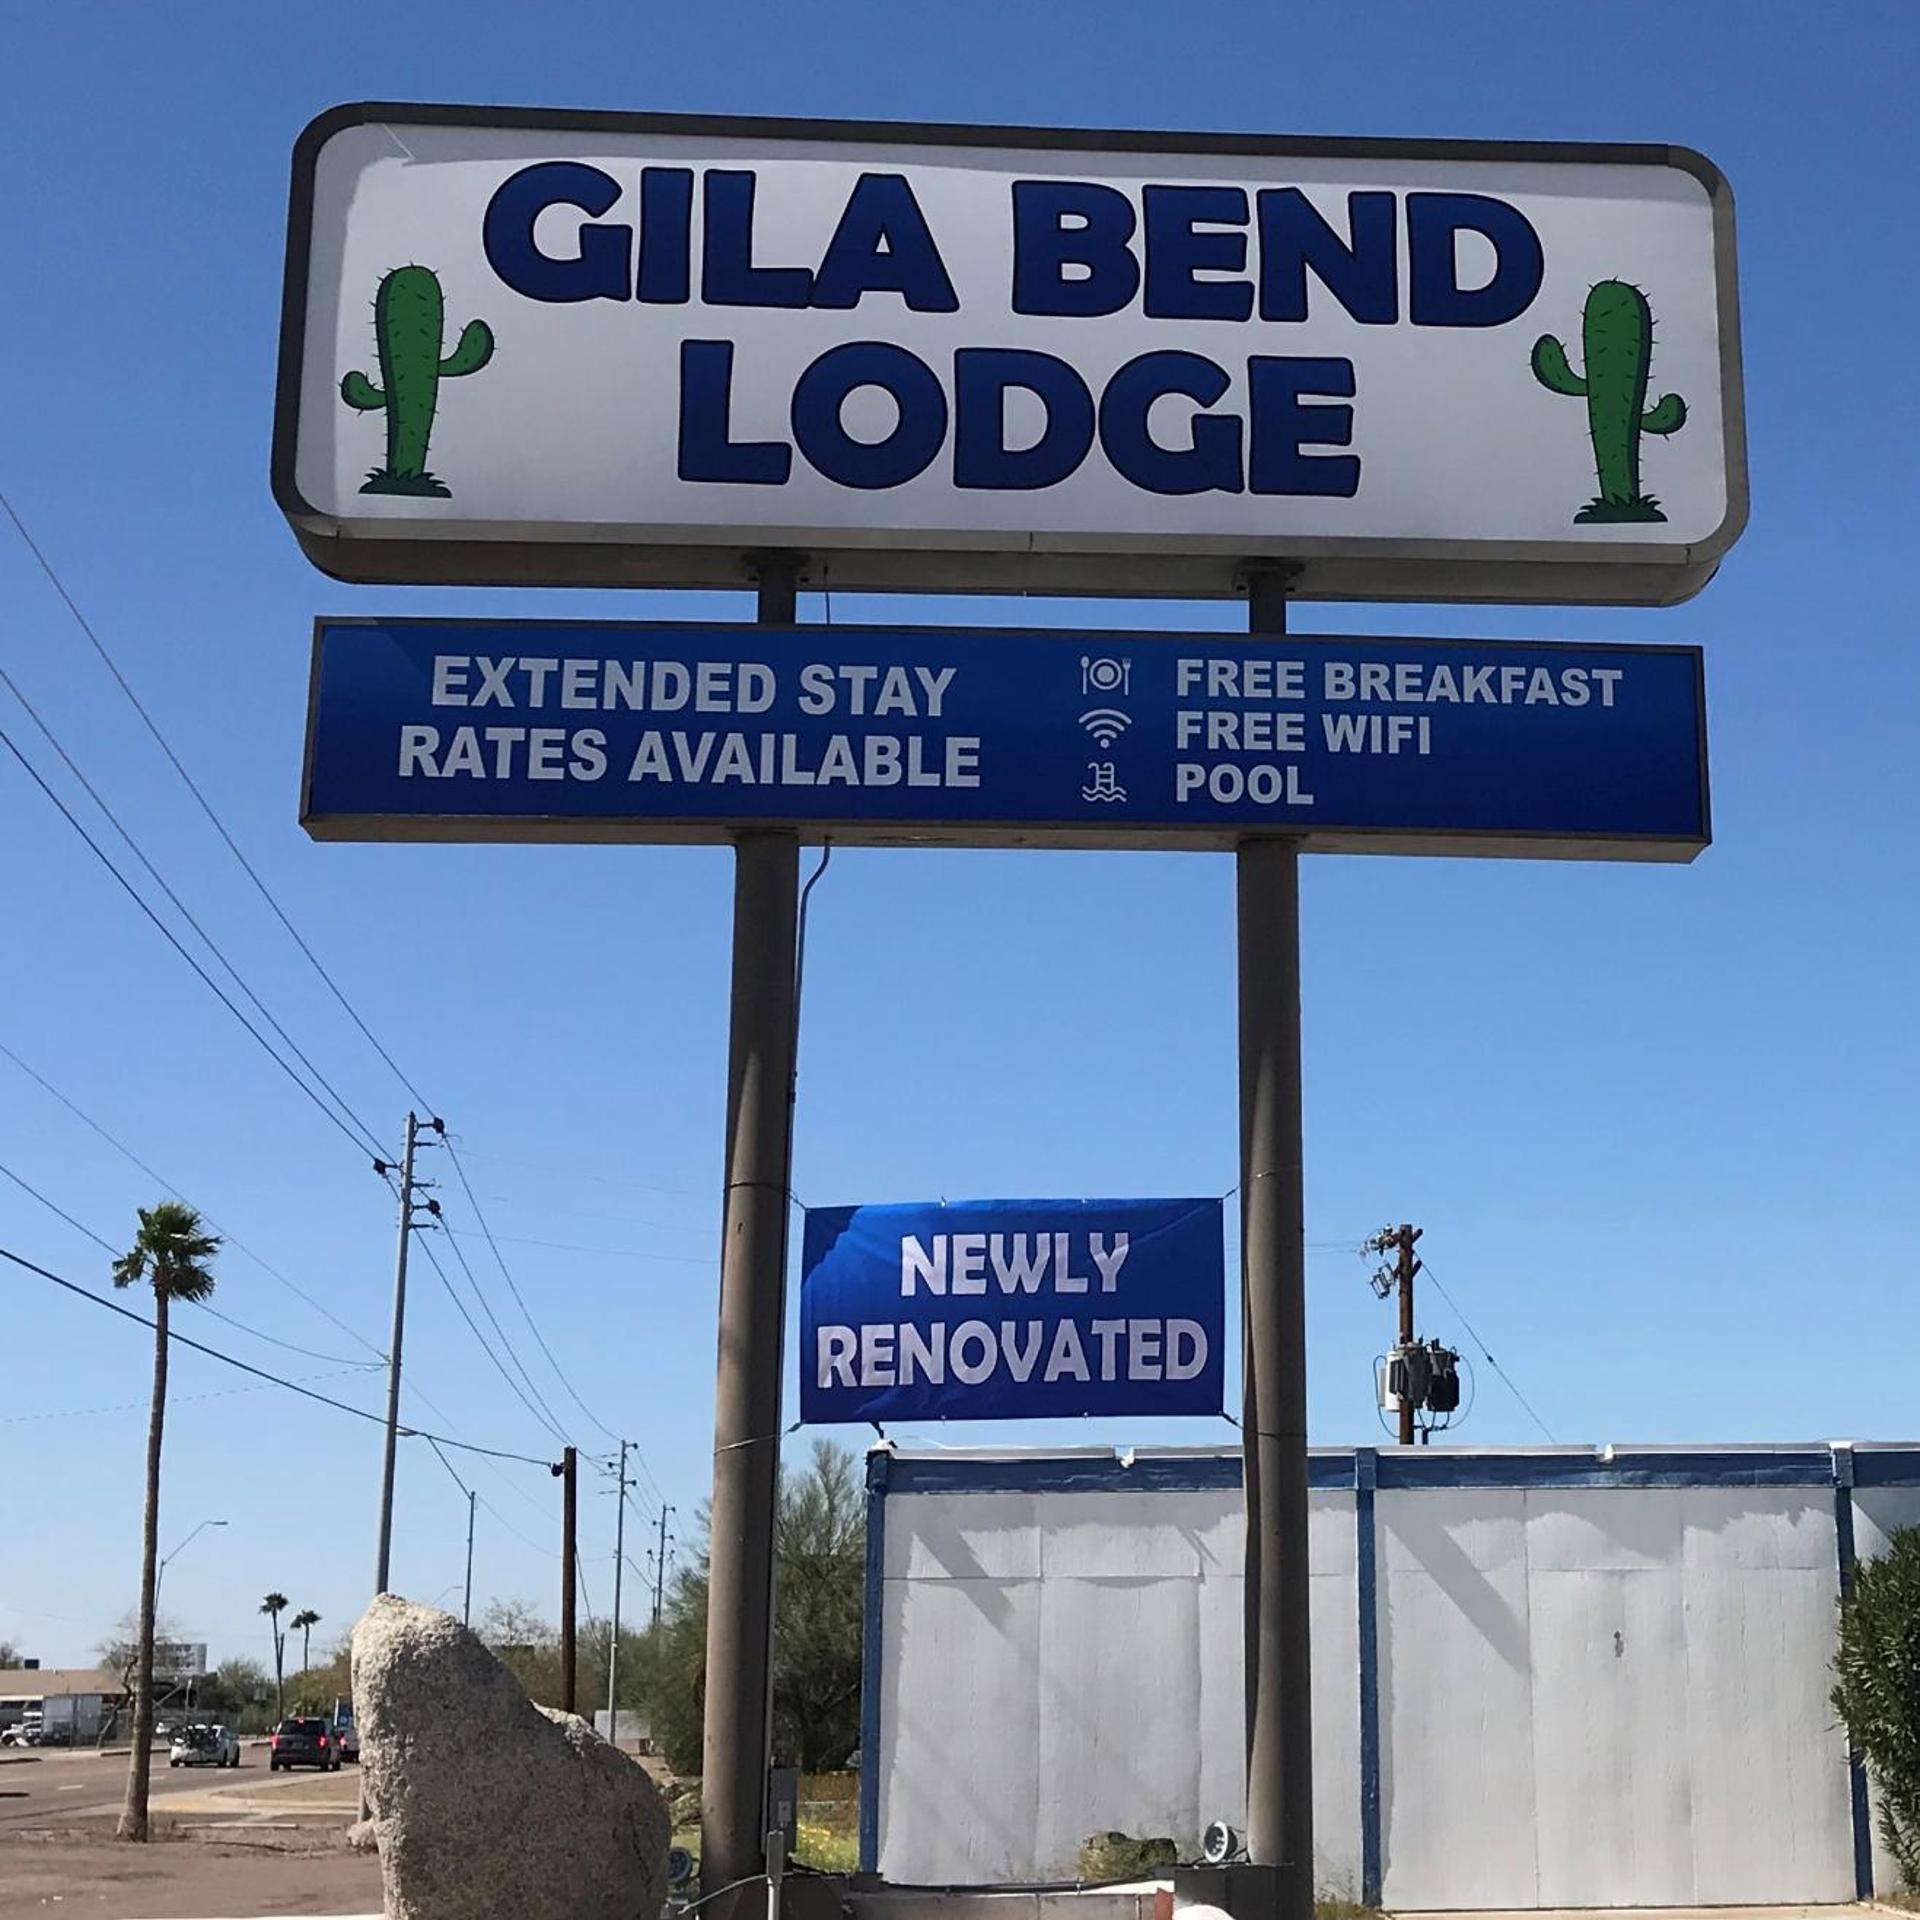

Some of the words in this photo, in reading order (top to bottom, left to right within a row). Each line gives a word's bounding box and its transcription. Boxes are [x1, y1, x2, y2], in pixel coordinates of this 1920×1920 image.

[483, 160, 960, 314] GILA
[1011, 179, 1545, 328] BEND
[677, 338, 1362, 499] LODGE
[432, 655, 776, 713] EXTENDED
[798, 664, 957, 717] STAY
[1177, 658, 1305, 698] FREE
[1324, 662, 1623, 707] BREAKFAST
[398, 725, 608, 781] RATES
[627, 730, 981, 788] AVAILABLE
[1177, 710, 1306, 751] FREE
[1322, 714, 1431, 755] WIFI
[1176, 763, 1314, 805] POOL
[900, 1231, 1130, 1297] NEWLY
[816, 1318, 1209, 1389] RENOVATED
